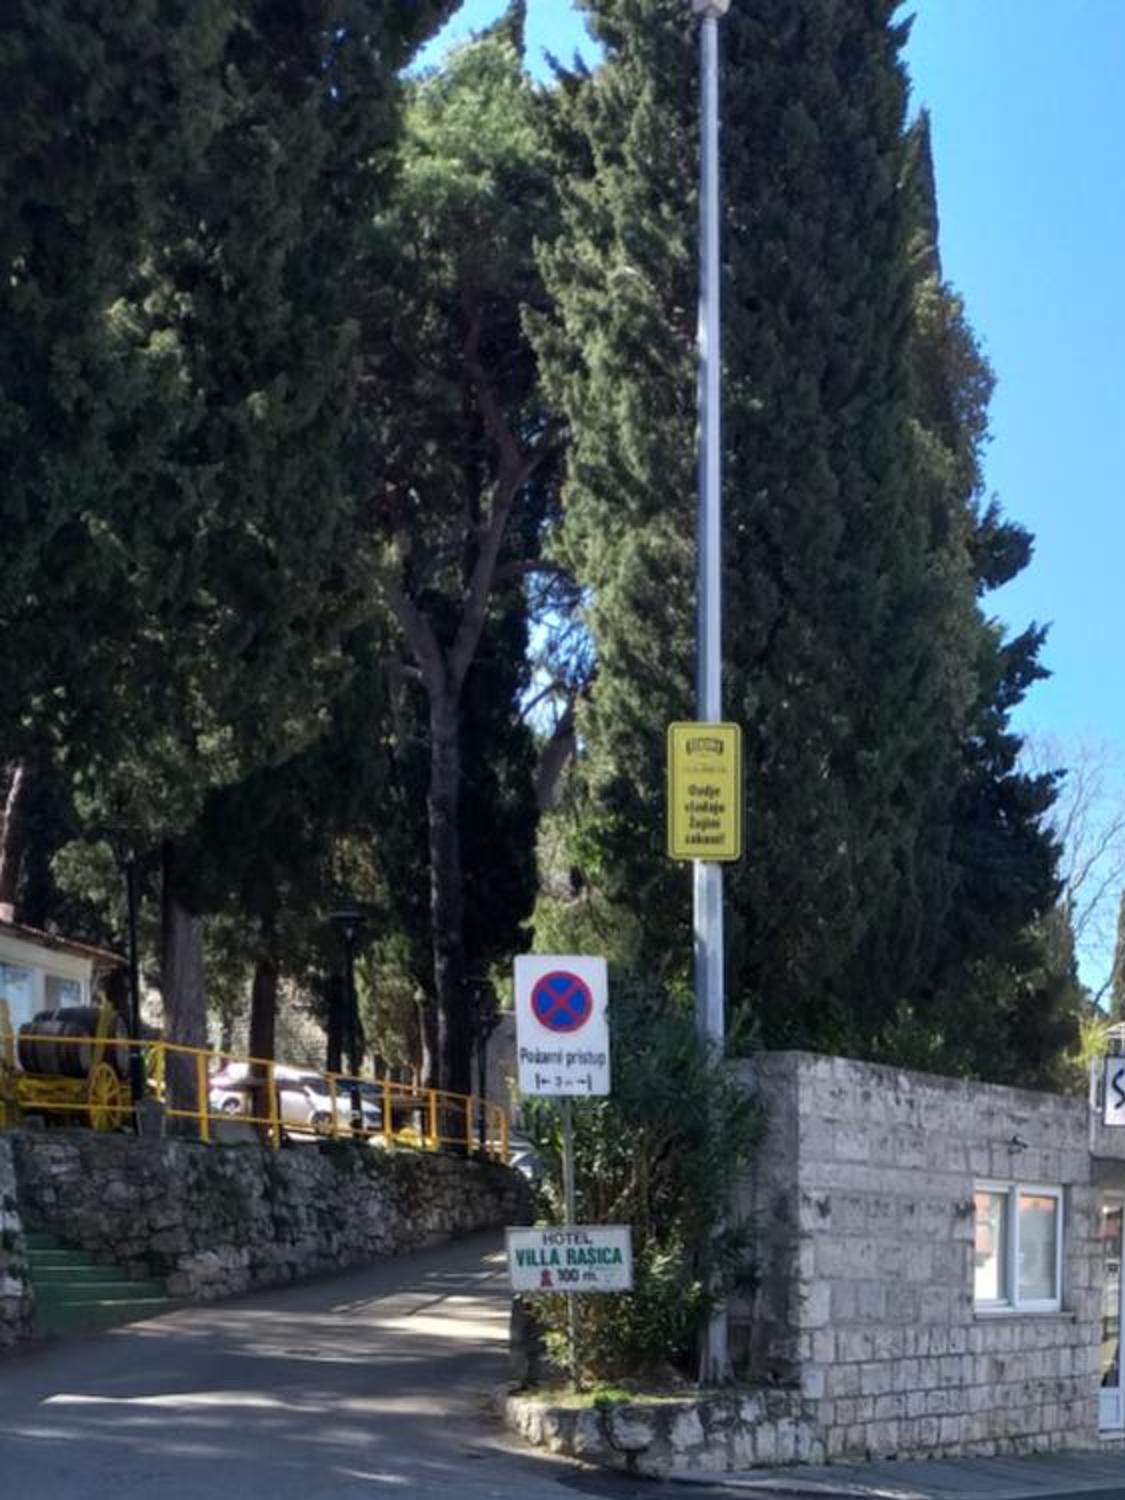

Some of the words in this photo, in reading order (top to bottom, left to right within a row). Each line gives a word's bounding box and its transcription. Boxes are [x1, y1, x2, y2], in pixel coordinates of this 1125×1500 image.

[566, 1048, 606, 1068] pristup
[543, 1231, 592, 1245] HOTEL
[515, 1248, 560, 1266] VILLA
